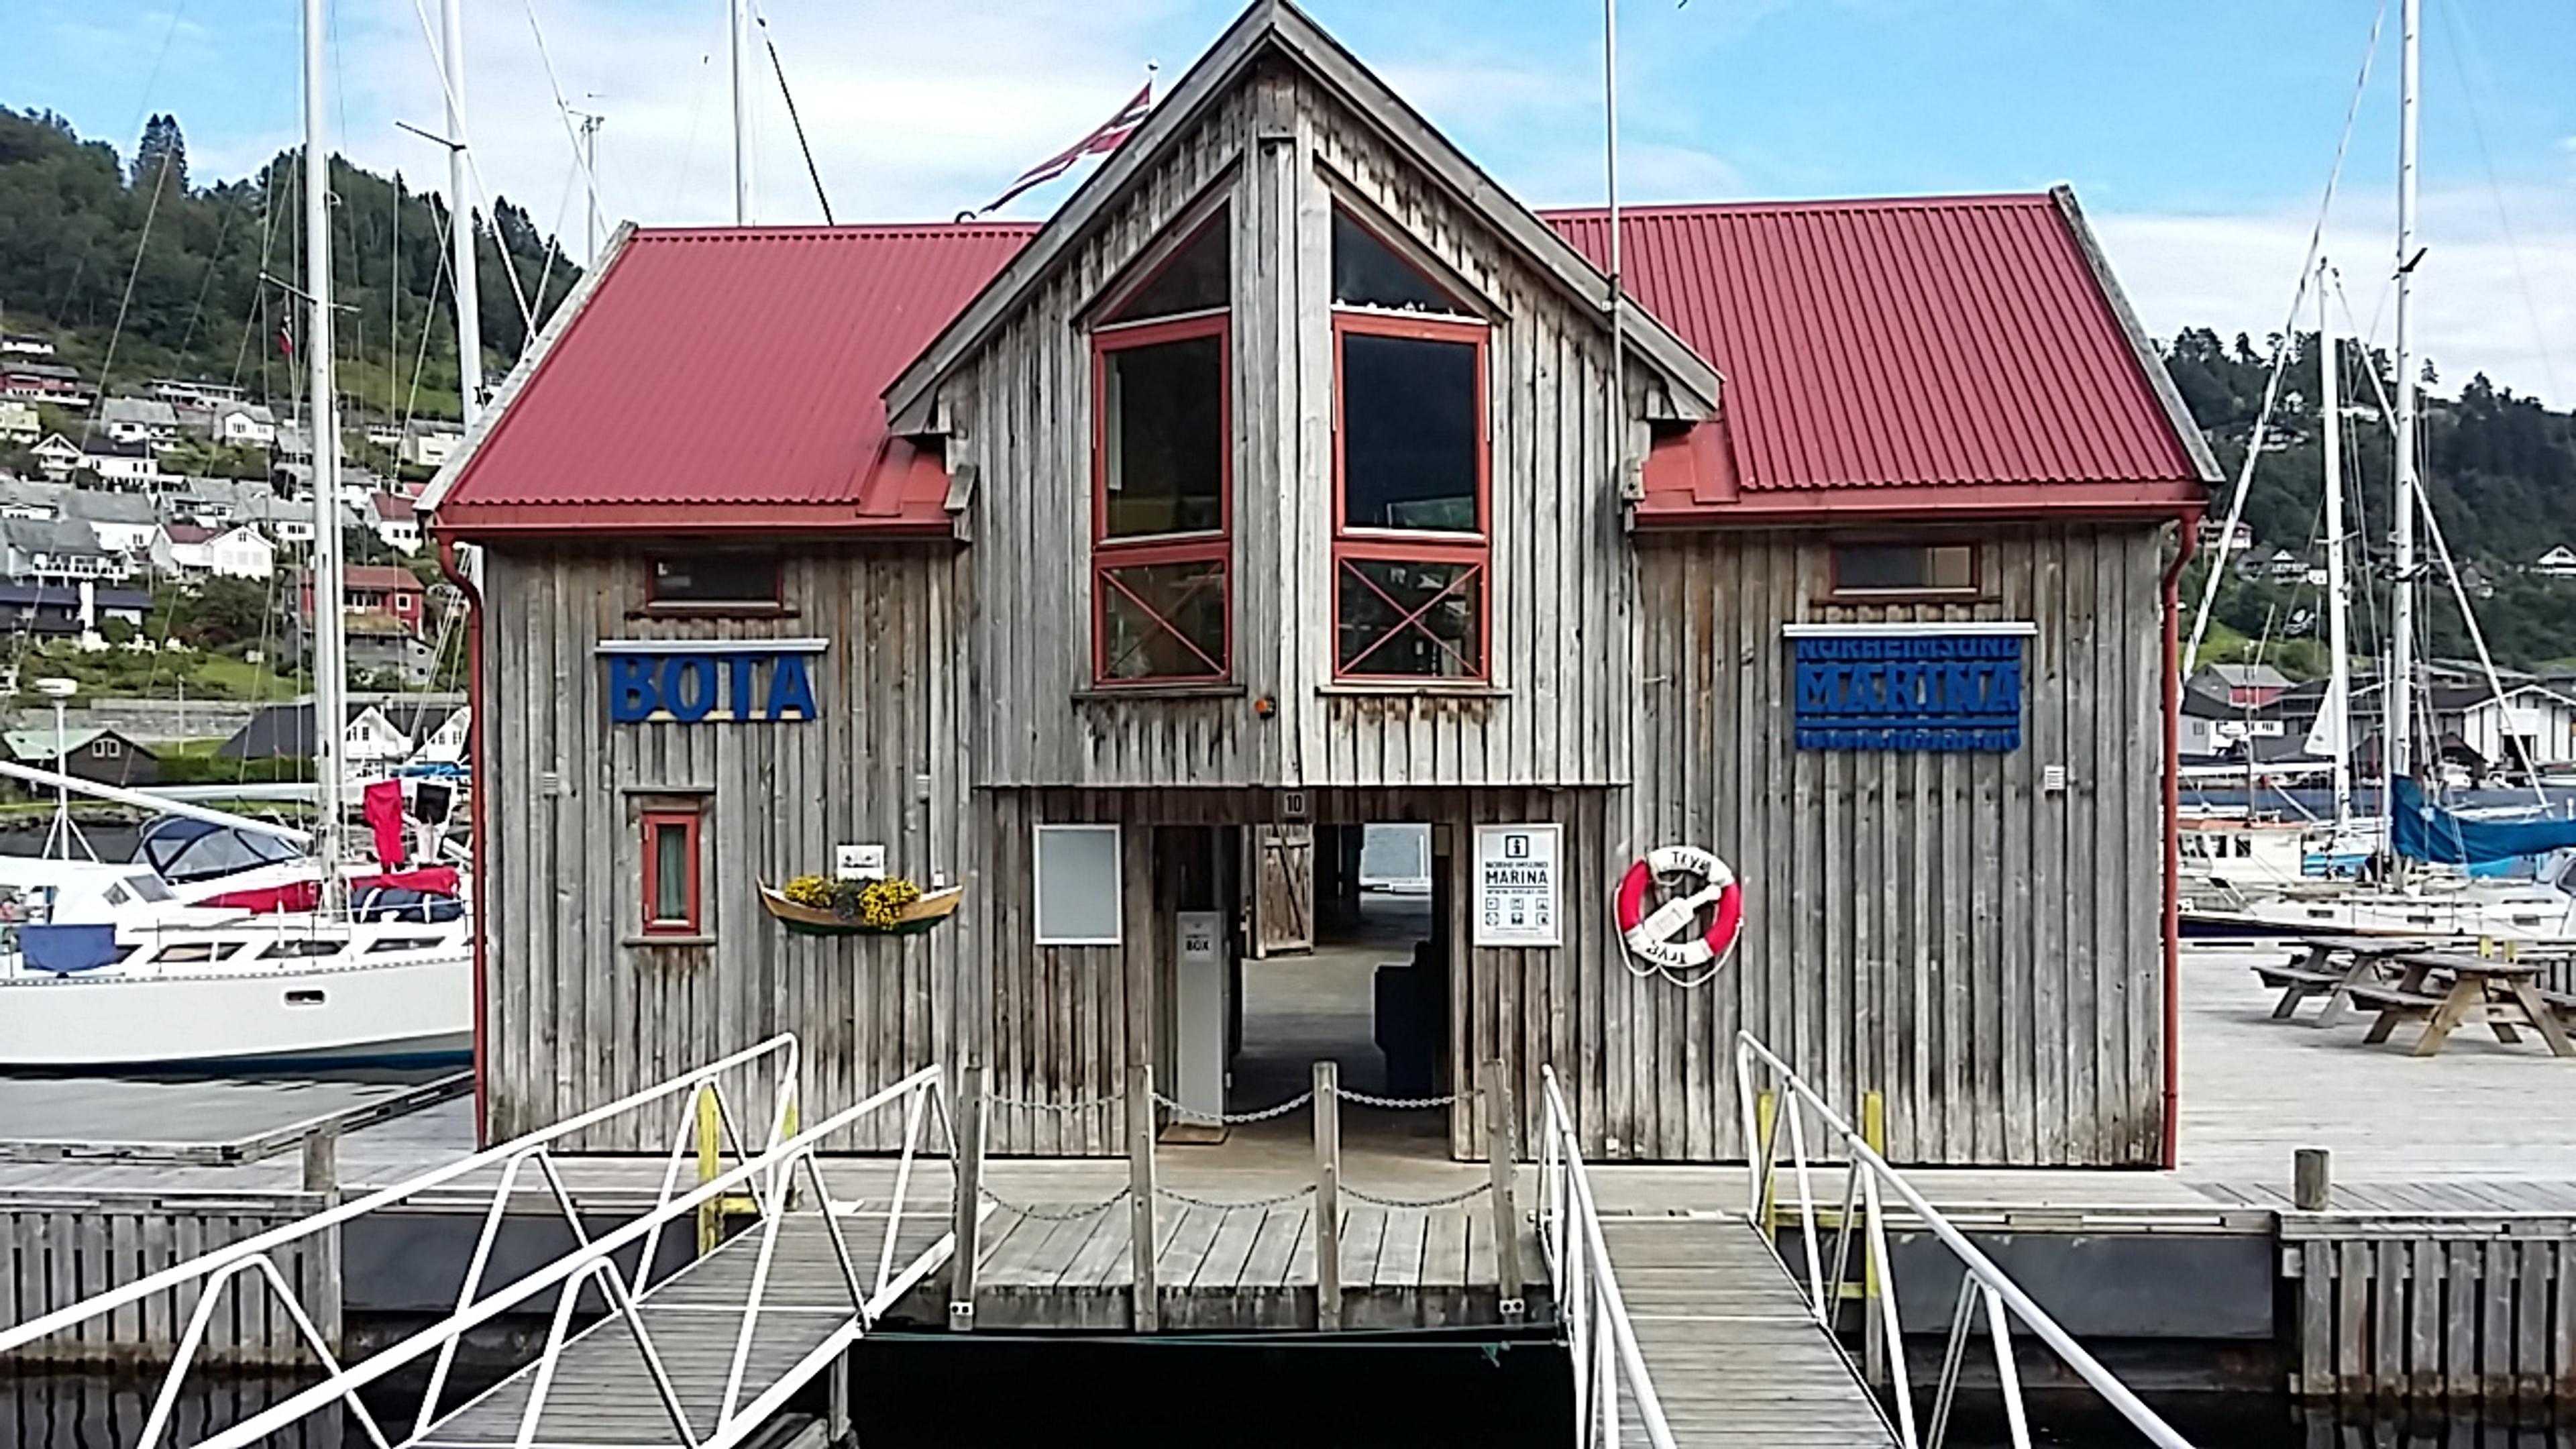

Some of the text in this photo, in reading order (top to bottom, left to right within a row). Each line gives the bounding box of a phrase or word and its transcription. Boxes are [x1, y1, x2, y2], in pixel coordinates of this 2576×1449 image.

[610, 653, 817, 721] BOTA
[1796, 661, 2021, 713] MARINA
[1287, 794, 1303, 812] 10
[1485, 870, 1548, 884] MARINA
[1187, 940, 1210, 951] BOX
